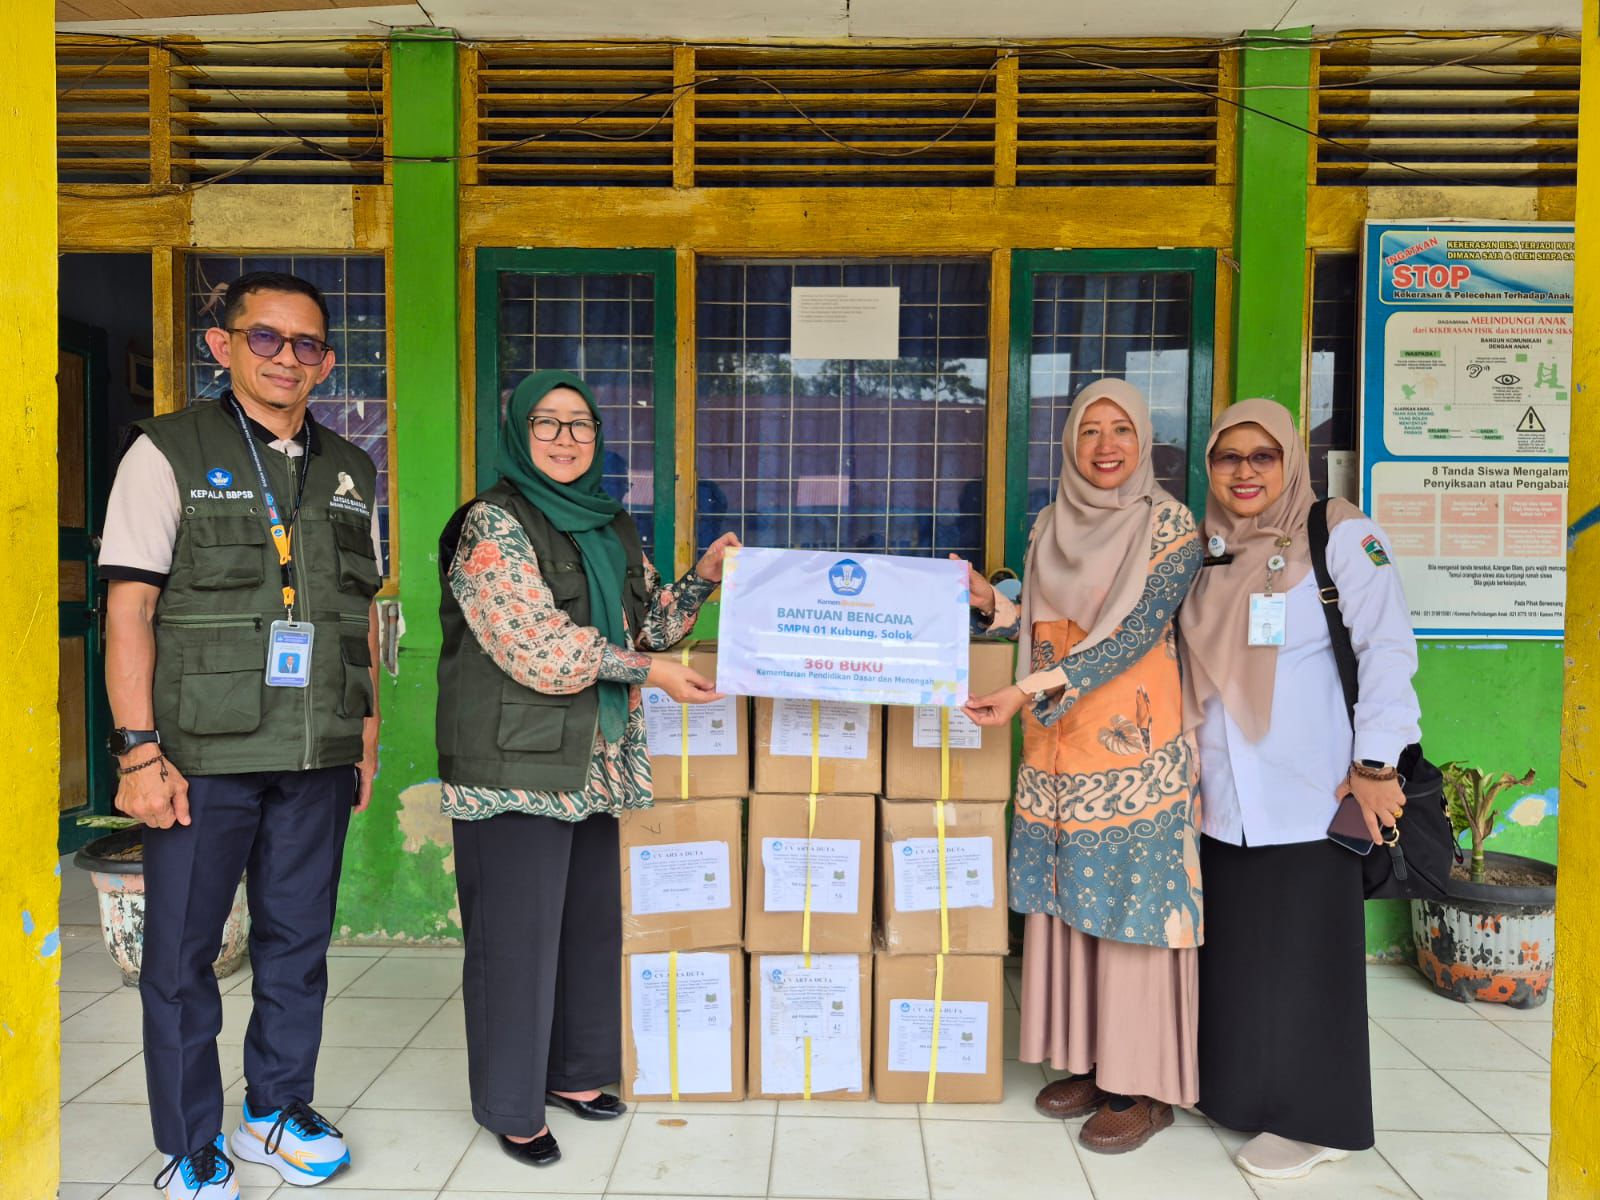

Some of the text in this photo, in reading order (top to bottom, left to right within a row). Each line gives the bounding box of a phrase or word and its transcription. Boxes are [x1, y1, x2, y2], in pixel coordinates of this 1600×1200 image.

[1447, 240, 1497, 249] KEKERASAN
[1499, 241, 1518, 249] BISA
[1520, 241, 1554, 250] TERJADI
[1385, 236, 1438, 266] INGATKAN
[1447, 251, 1480, 259] DIMANA
[1513, 252, 1535, 260] OLEH
[1536, 252, 1562, 260] SIAPA
[1392, 264, 1471, 288] STOP
[1504, 292, 1545, 301] Terhadap
[1471, 316, 1535, 325] MELINDUNGI
[1538, 317, 1566, 325] ANAK
[1432, 466, 1438, 476] 8
[1441, 466, 1474, 476] Tanda
[1478, 466, 1510, 476] Siswa
[1424, 479, 1486, 490] Penyiksaan
[1489, 480, 1512, 488] atau
[190, 489, 254, 499] KEPALA BBPSB
[777, 607, 914, 626] BANTUAN BENCANA
[777, 624, 913, 640] SMPN 01 Kubung, Solok
[804, 658, 883, 673] 360 BUKU
[809, 671, 851, 680] Pendidikan
[853, 674, 875, 682] Dasar
[894, 677, 934, 686] Menengah
